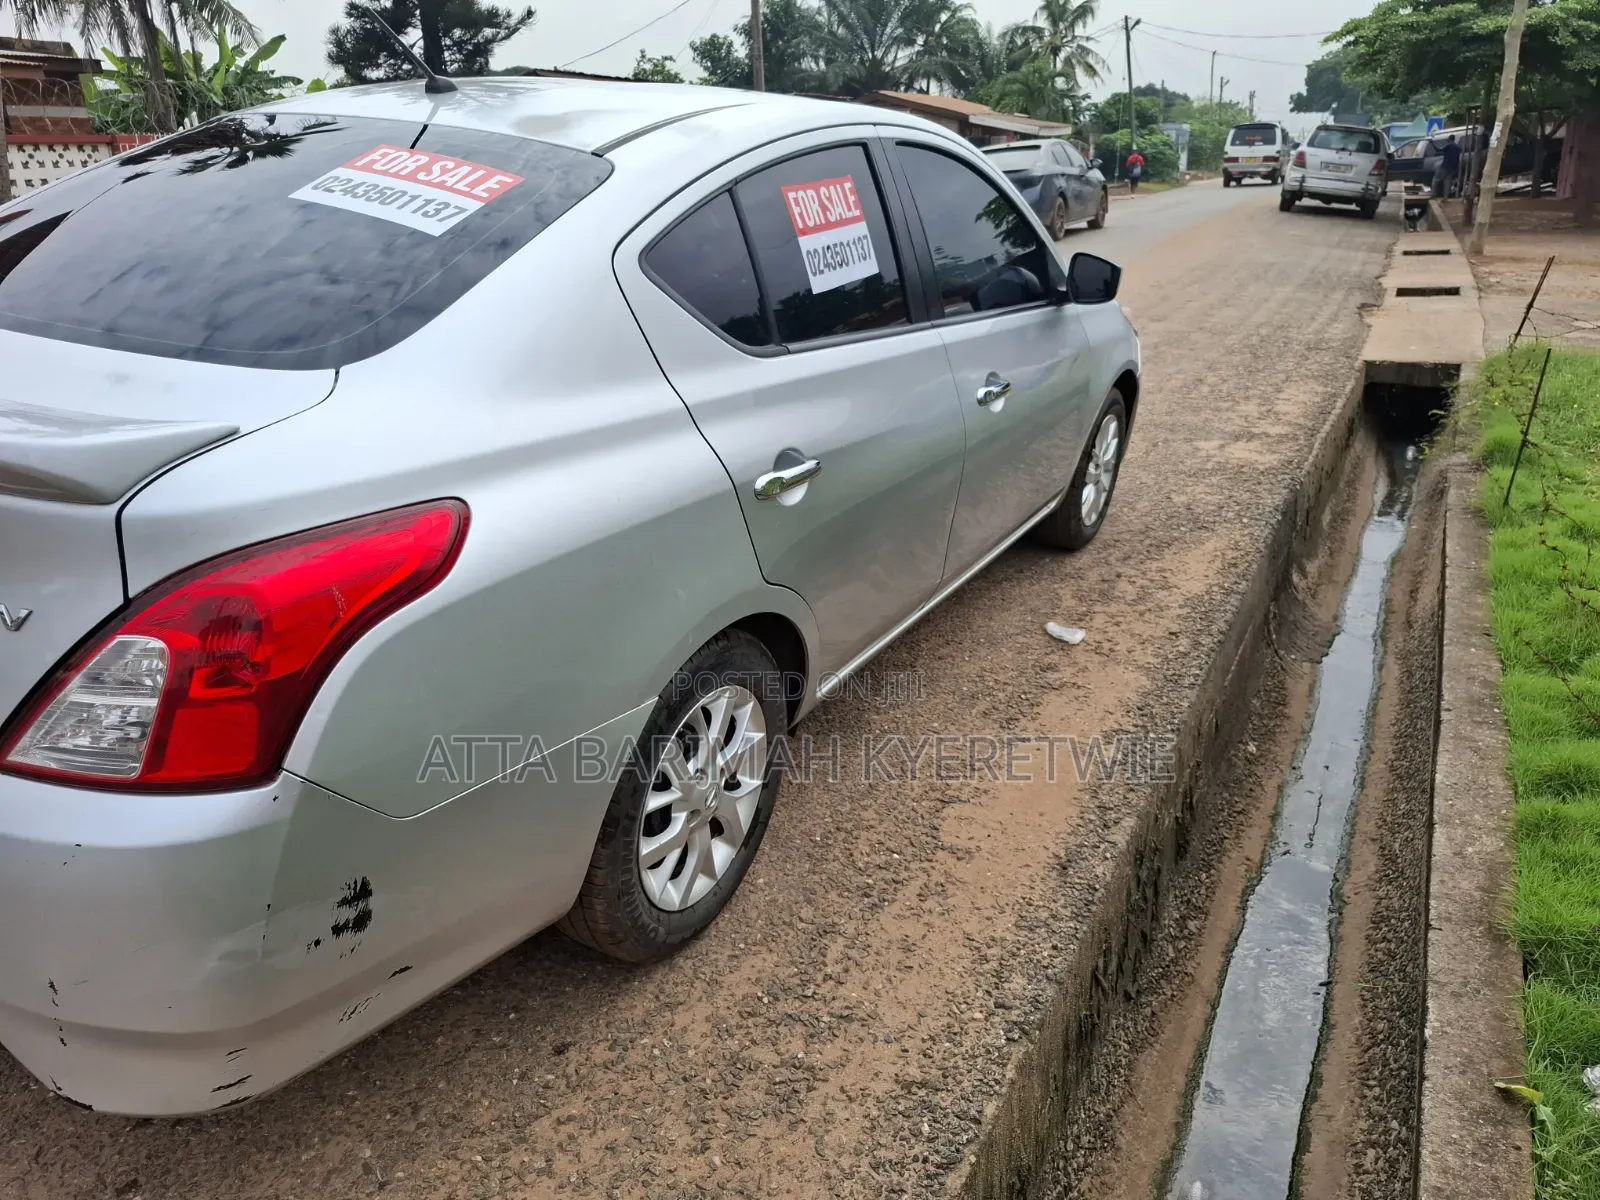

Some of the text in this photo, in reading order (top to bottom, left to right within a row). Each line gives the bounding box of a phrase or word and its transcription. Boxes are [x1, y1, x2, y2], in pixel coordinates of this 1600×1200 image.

[355, 148, 514, 198] FOR SALE
[311, 175, 469, 223] 0243501137
[787, 182, 861, 229] FOR SALE
[805, 234, 872, 278] 0243501137
